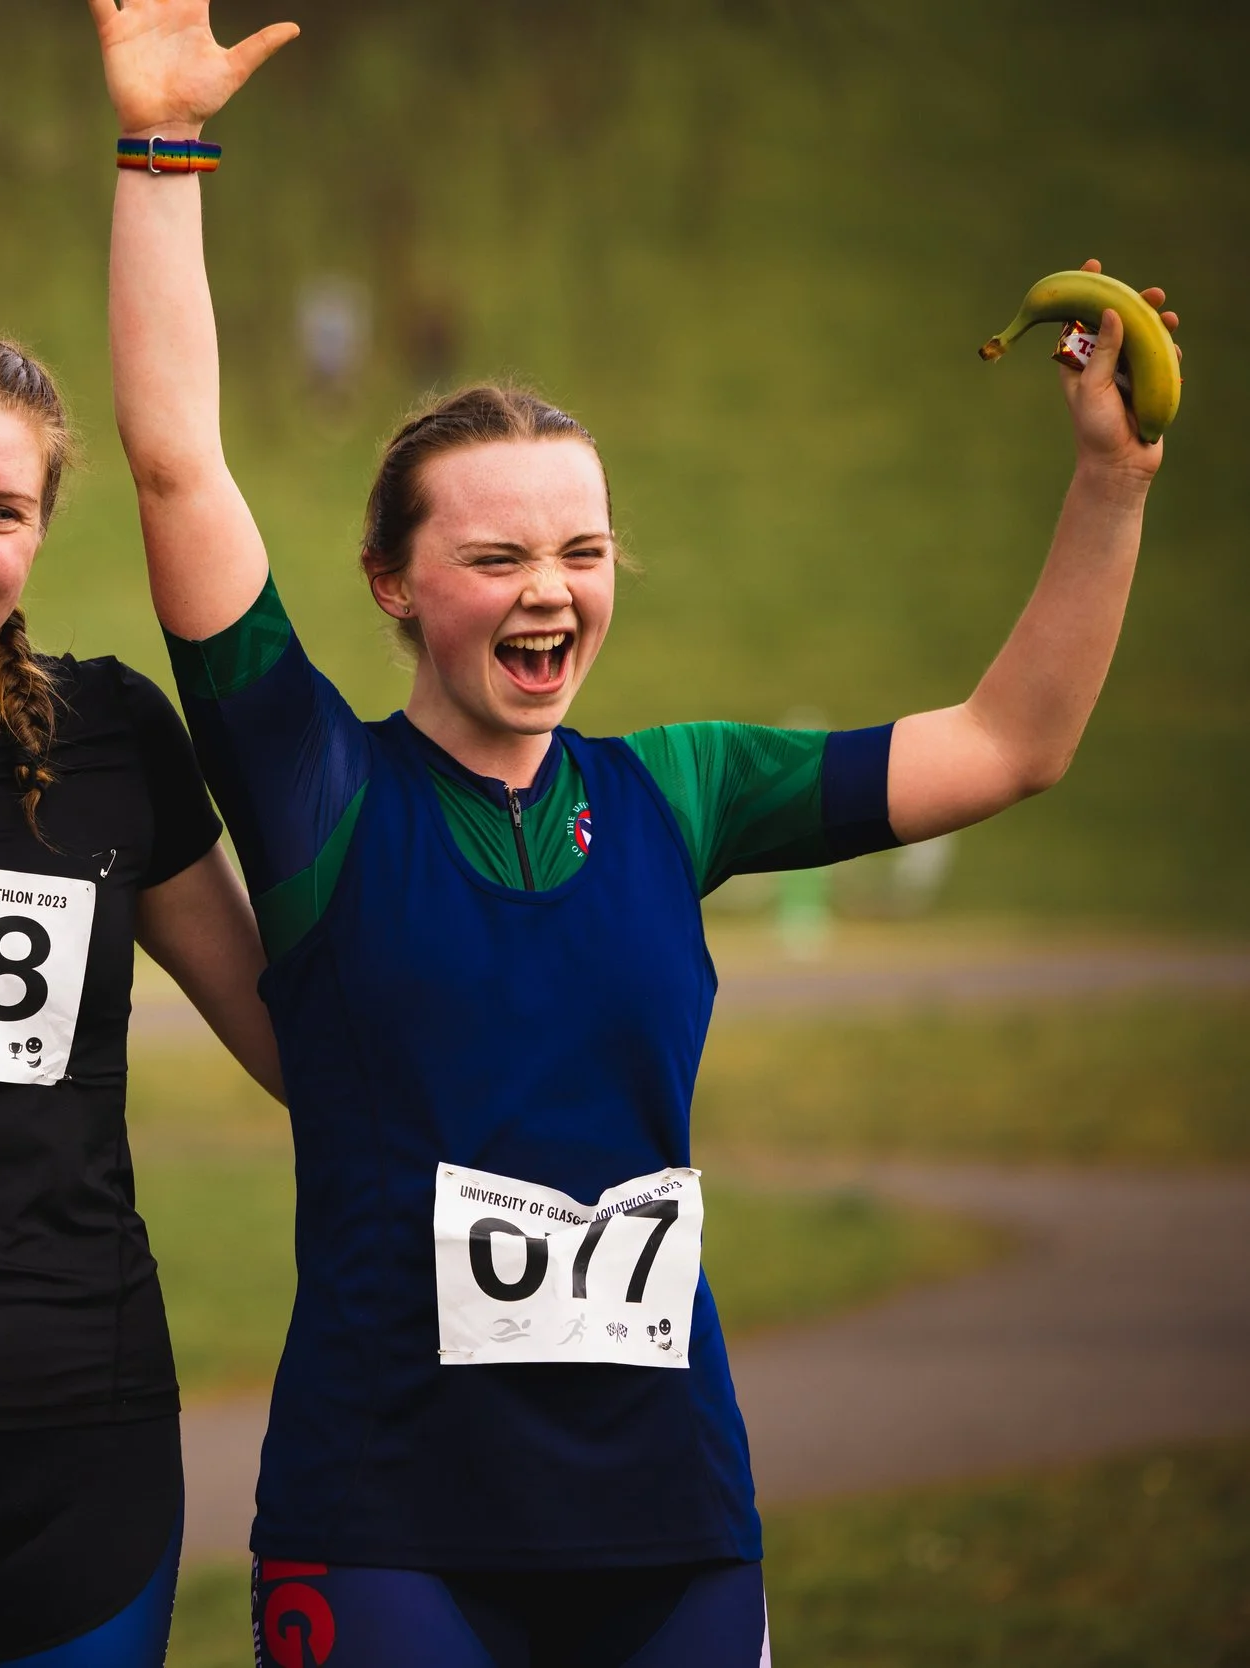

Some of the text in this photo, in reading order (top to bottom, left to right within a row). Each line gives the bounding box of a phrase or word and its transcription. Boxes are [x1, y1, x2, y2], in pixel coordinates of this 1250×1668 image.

[566, 815, 576, 836] THE
[571, 845, 585, 858] OF
[37, 893, 68, 910] 2023
[460, 1184, 527, 1213] UNIVERSITY
[529, 1202, 545, 1217] OF
[547, 1206, 592, 1227] GLASG
